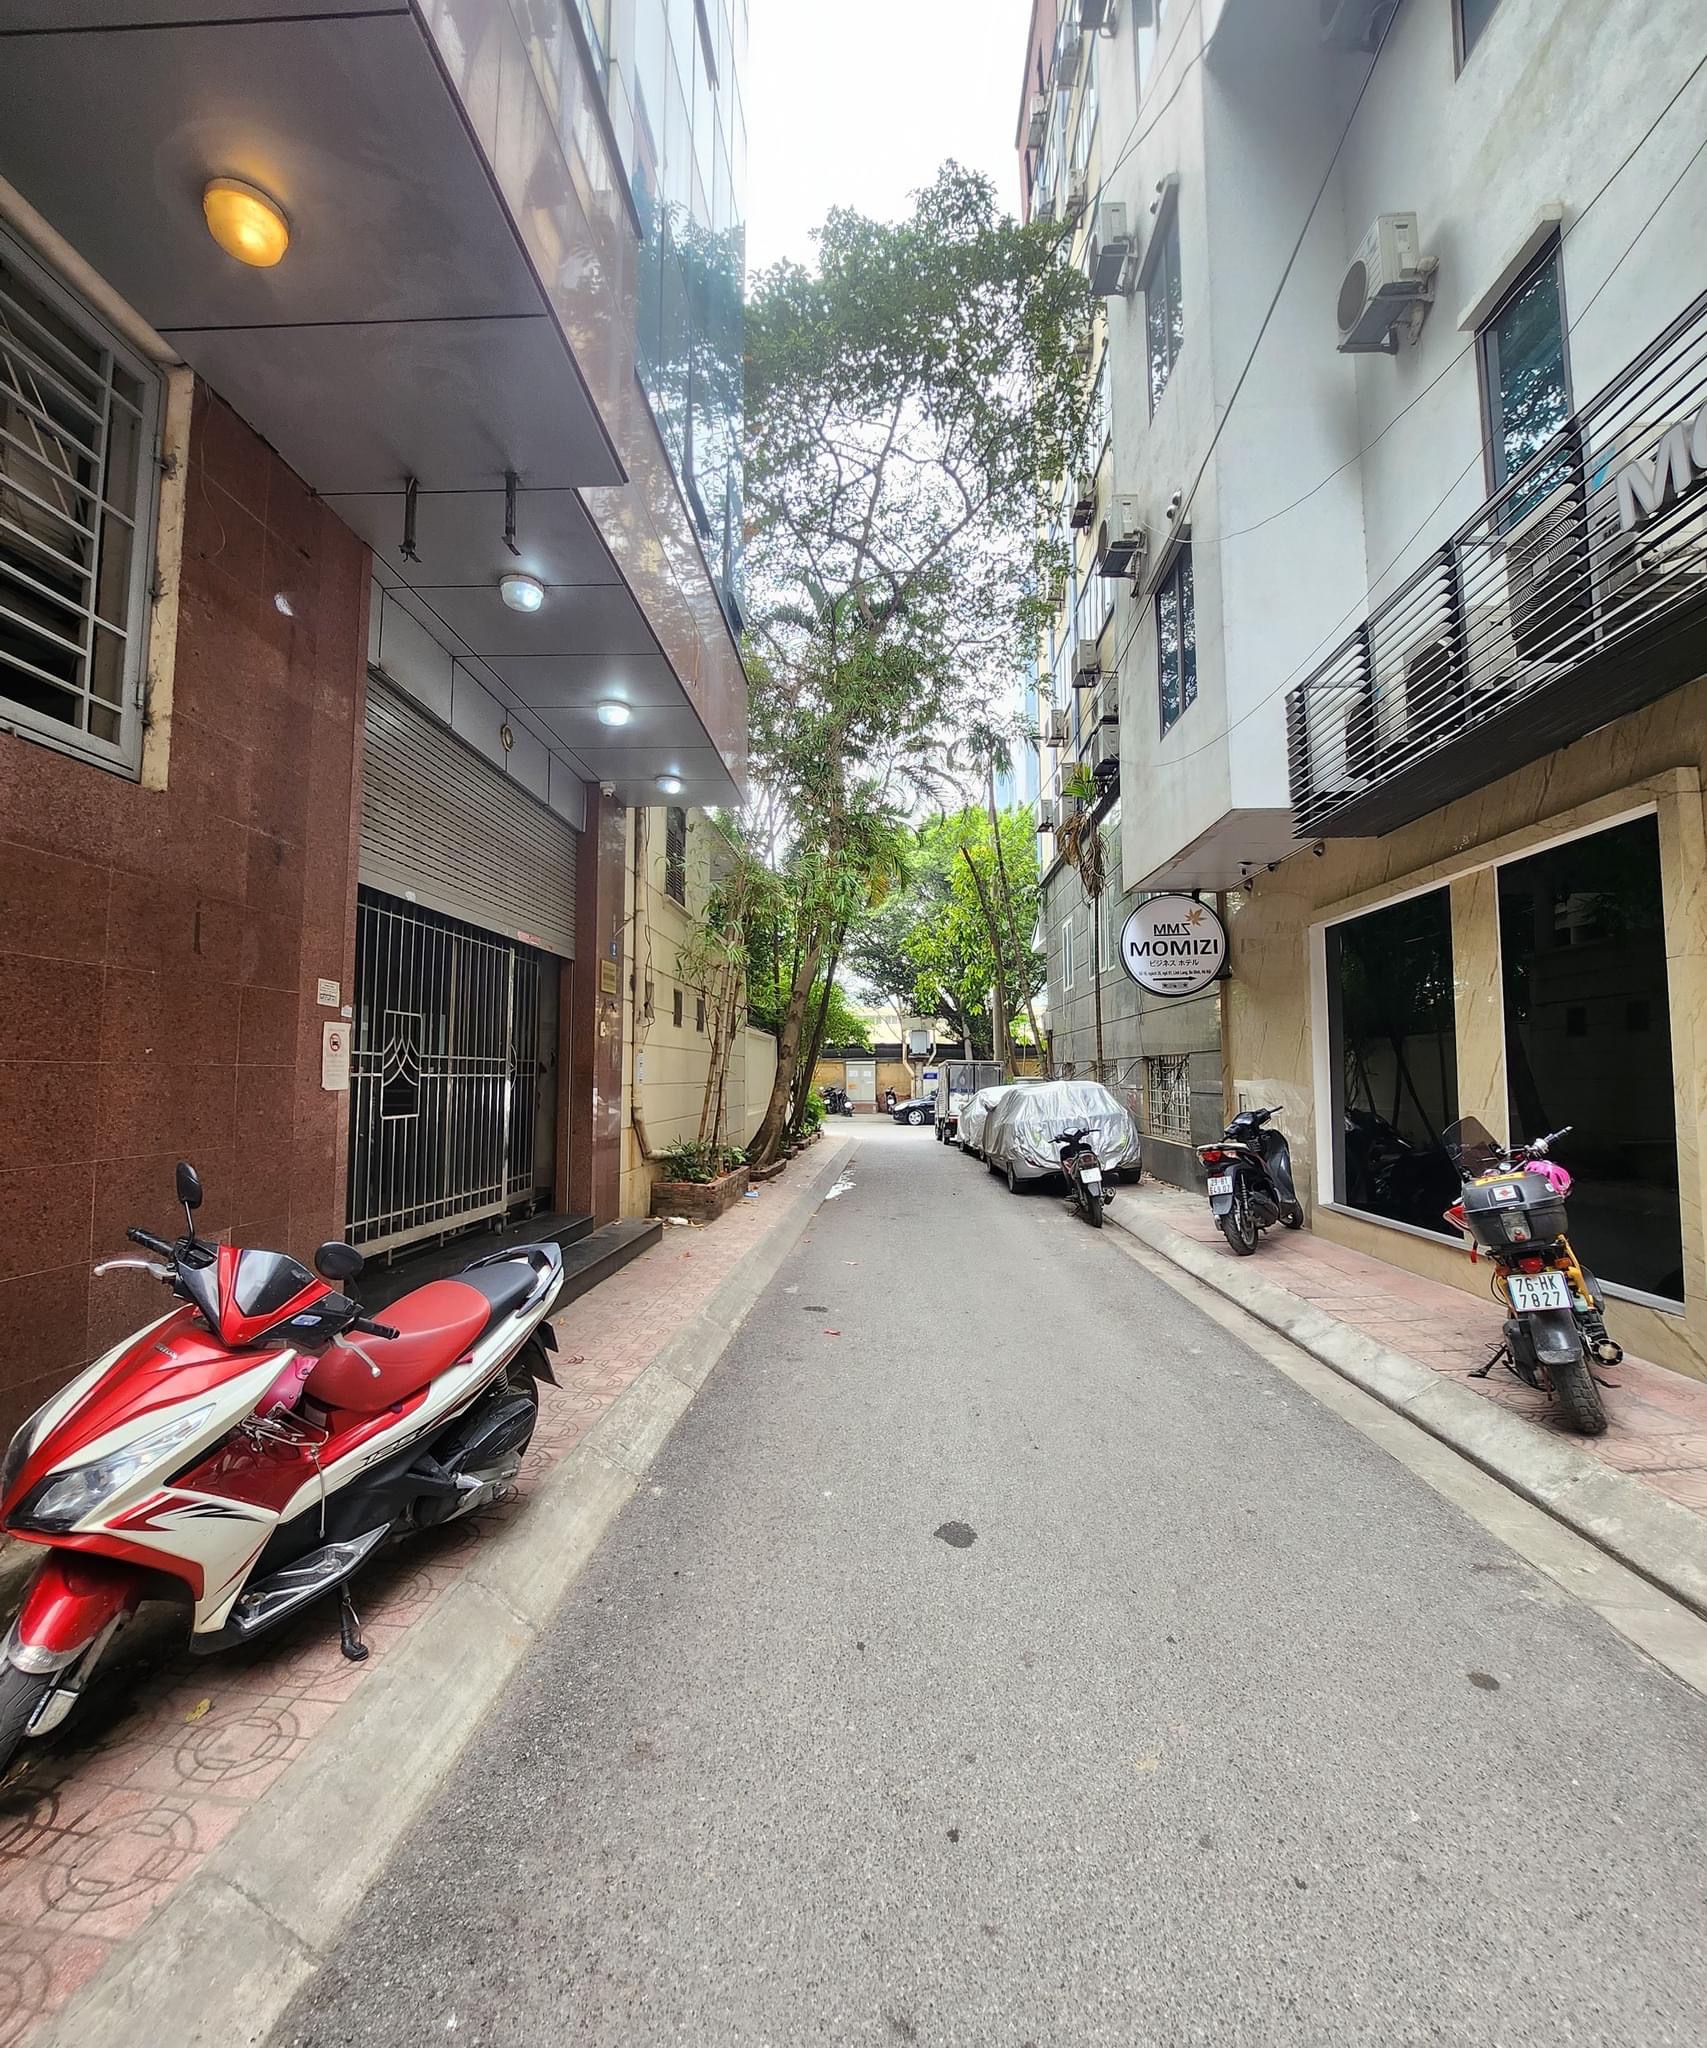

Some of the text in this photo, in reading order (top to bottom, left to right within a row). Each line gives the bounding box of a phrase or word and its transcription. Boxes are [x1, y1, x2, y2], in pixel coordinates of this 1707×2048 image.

[1130, 939, 1218, 956] MOMIZI
[1515, 1276, 1558, 1293] 76-HK
[1519, 1291, 1560, 1308] 7827
